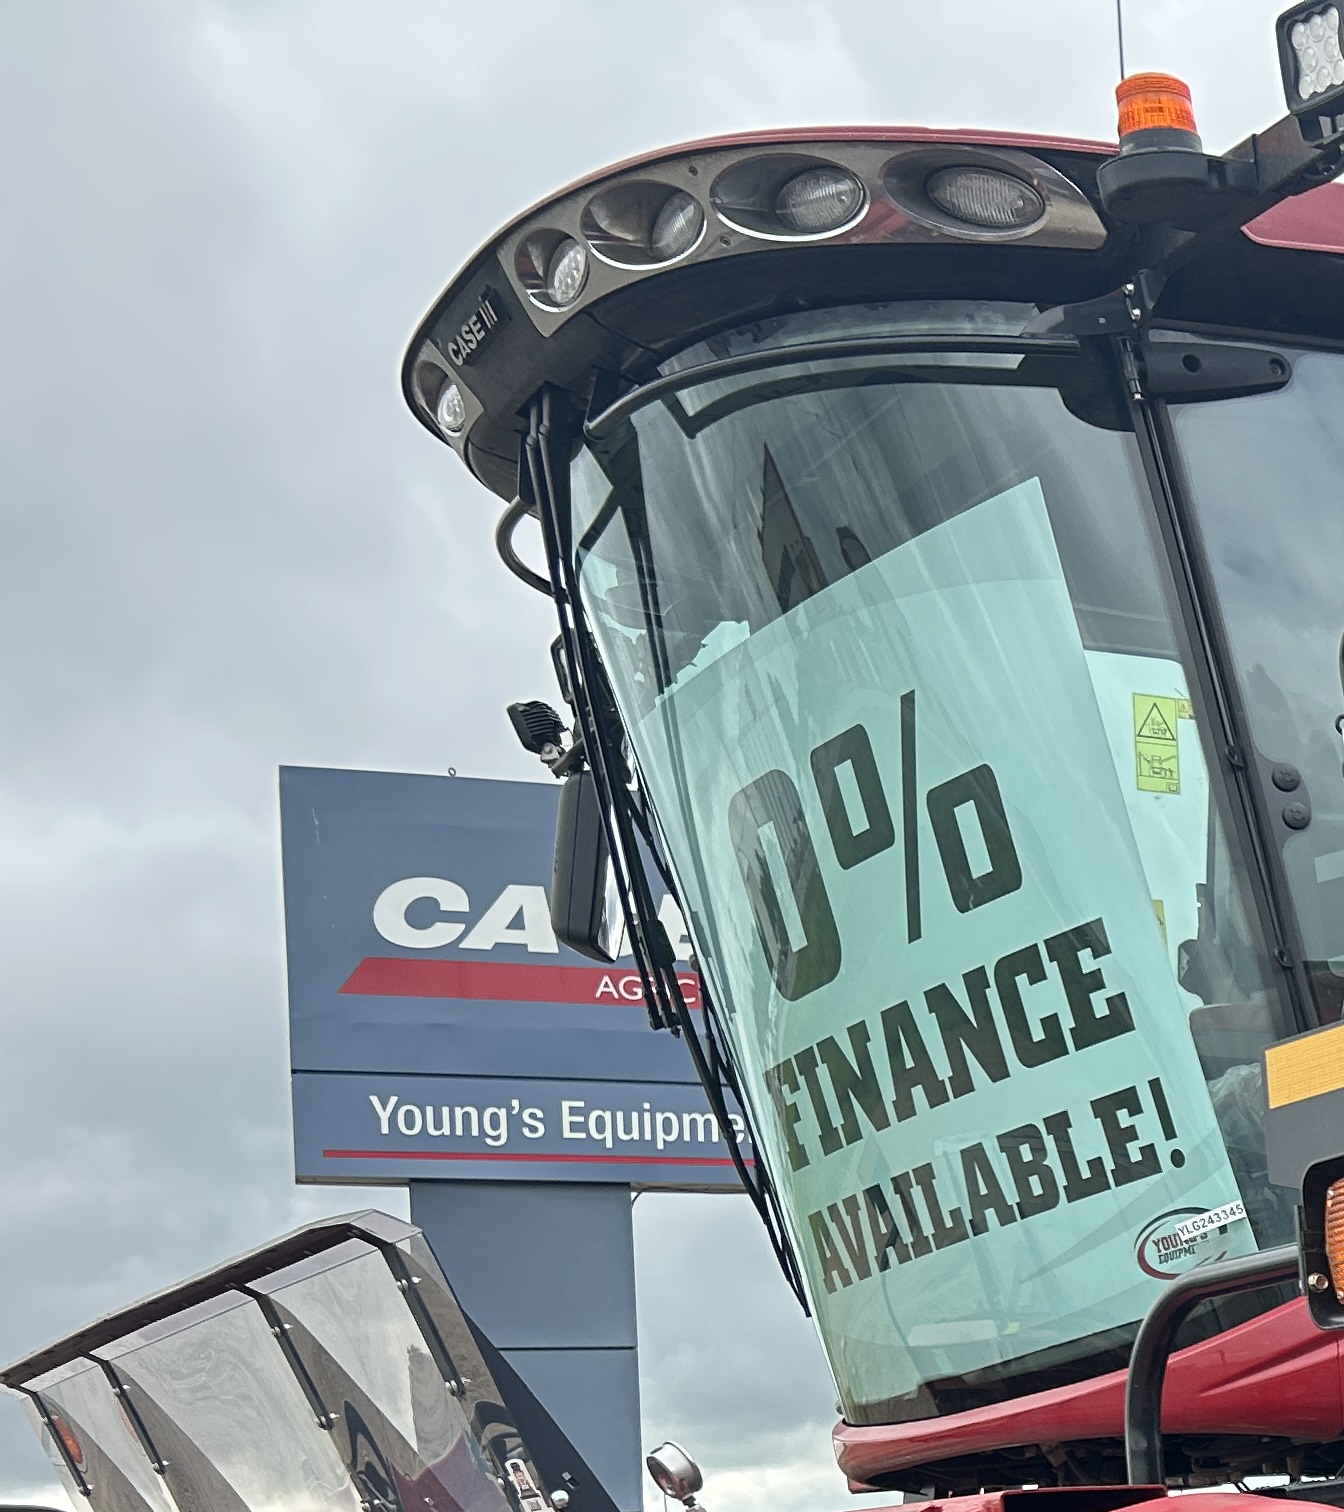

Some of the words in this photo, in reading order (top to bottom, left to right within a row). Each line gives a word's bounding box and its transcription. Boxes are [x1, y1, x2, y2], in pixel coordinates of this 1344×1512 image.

[448, 314, 486, 367] CASE
[727, 689, 1023, 1002] 0%
[762, 916, 1136, 1172] FINANCE
[369, 1095, 546, 1148] Young's
[806, 1076, 1187, 1294] AVAILABLE!
[1178, 1203, 1244, 1237] YLG243345
